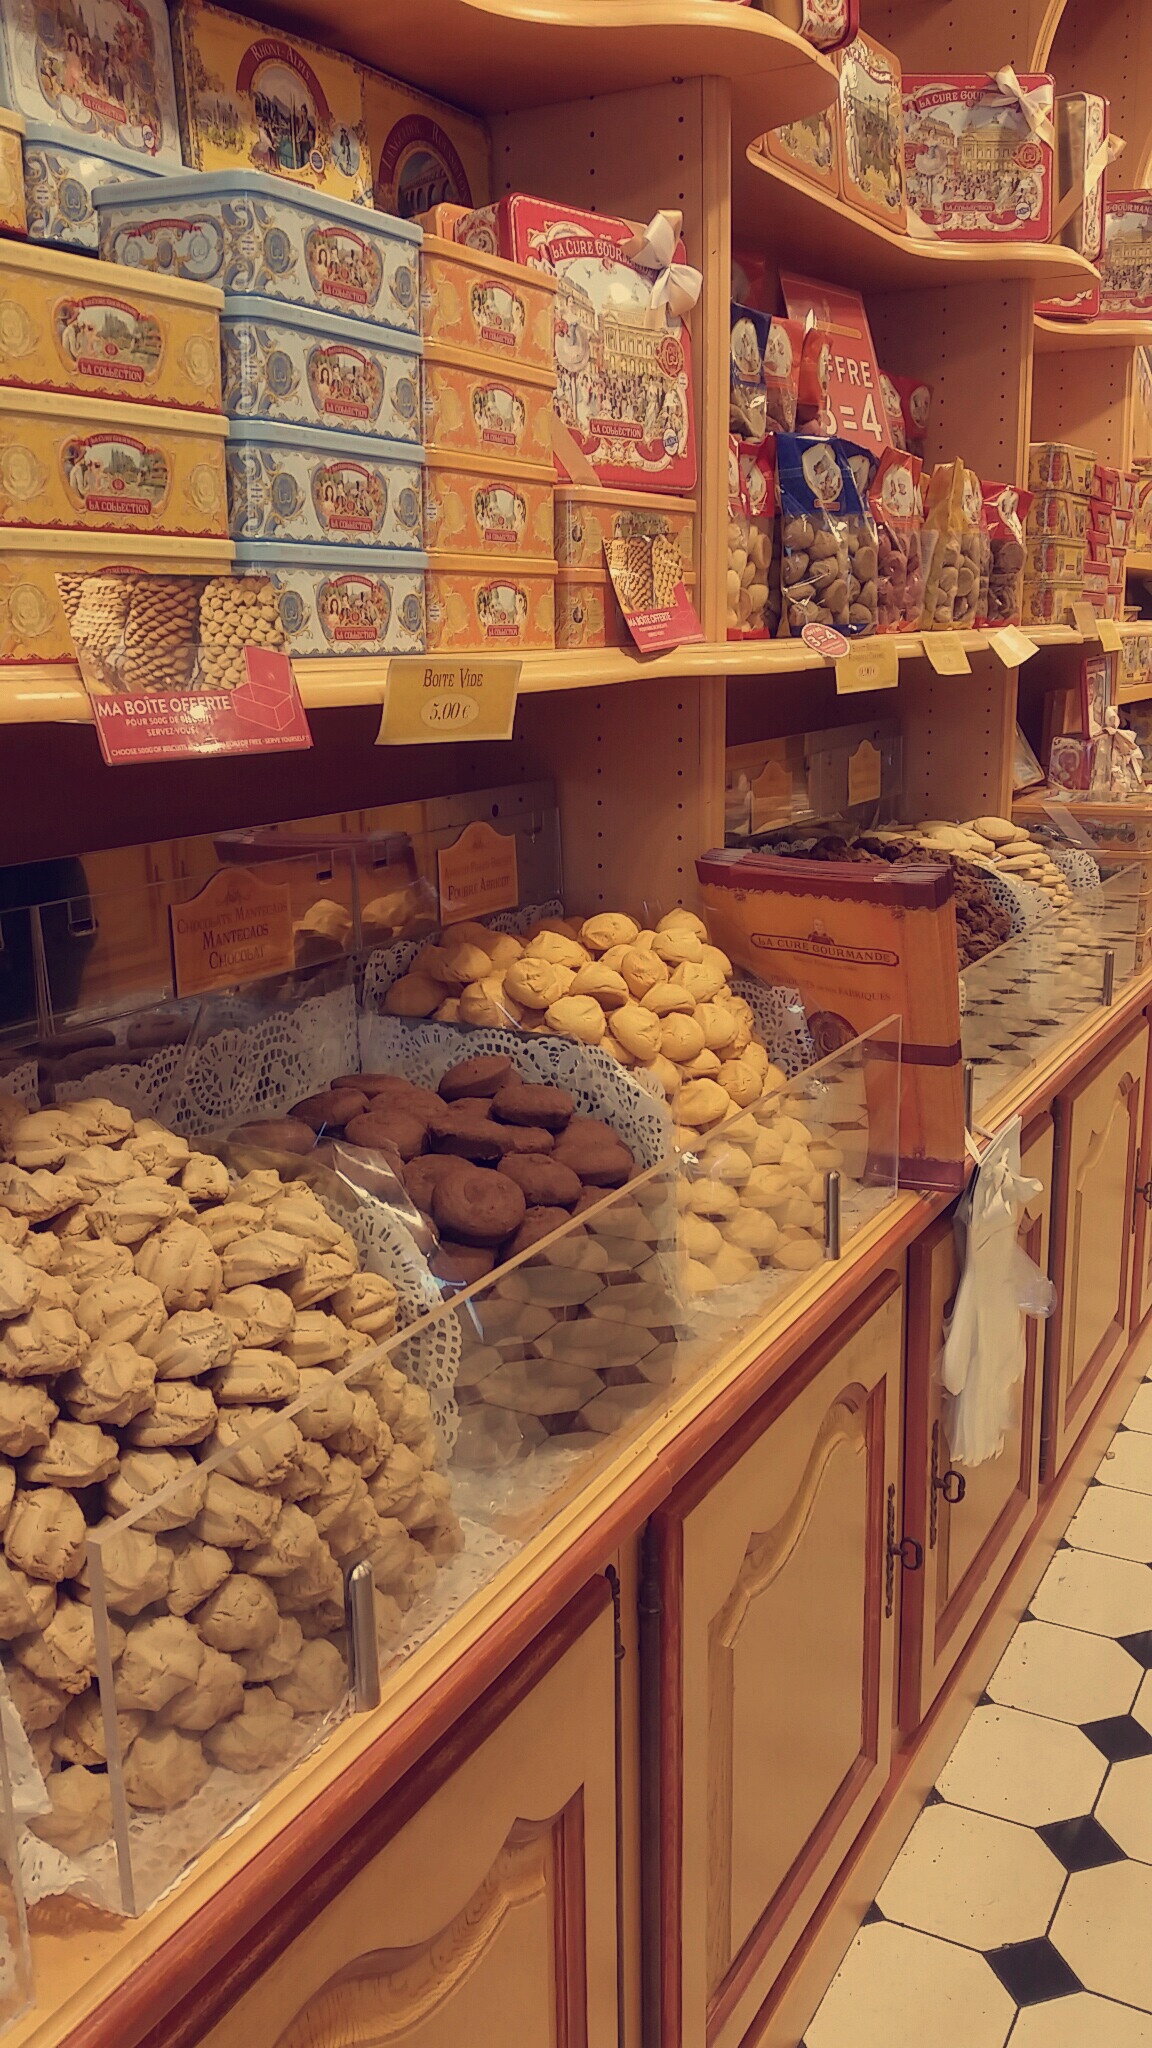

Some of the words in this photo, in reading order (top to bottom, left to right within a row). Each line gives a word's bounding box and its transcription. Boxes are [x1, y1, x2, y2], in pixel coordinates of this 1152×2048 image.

[932, 91, 958, 104] CURE
[551, 242, 566, 259] LA
[566, 239, 594, 256] CURE
[81, 362, 92, 374] LA
[94, 366, 142, 381] COLLECTION
[591, 424, 601, 434] LA
[602, 425, 642, 437] COLLECTION
[89, 499, 100, 511] LA
[101, 502, 149, 513] COLLECTION
[97, 701, 123, 717] MA
[124, 695, 168, 716] BOÎTE
[169, 695, 232, 713] OFFERTE
[125, 717, 148, 727] POUR
[149, 716, 168, 725] 500G
[169, 716, 178, 724] DE
[112, 748, 137, 757] CHOOSE
[202, 923, 269, 950] MANTECAOS
[209, 944, 265, 969] CHOCOLAT
[757, 936, 773, 947] LA
[777, 939, 809, 951] CURE
[812, 945, 892, 963] GOURMANDE
